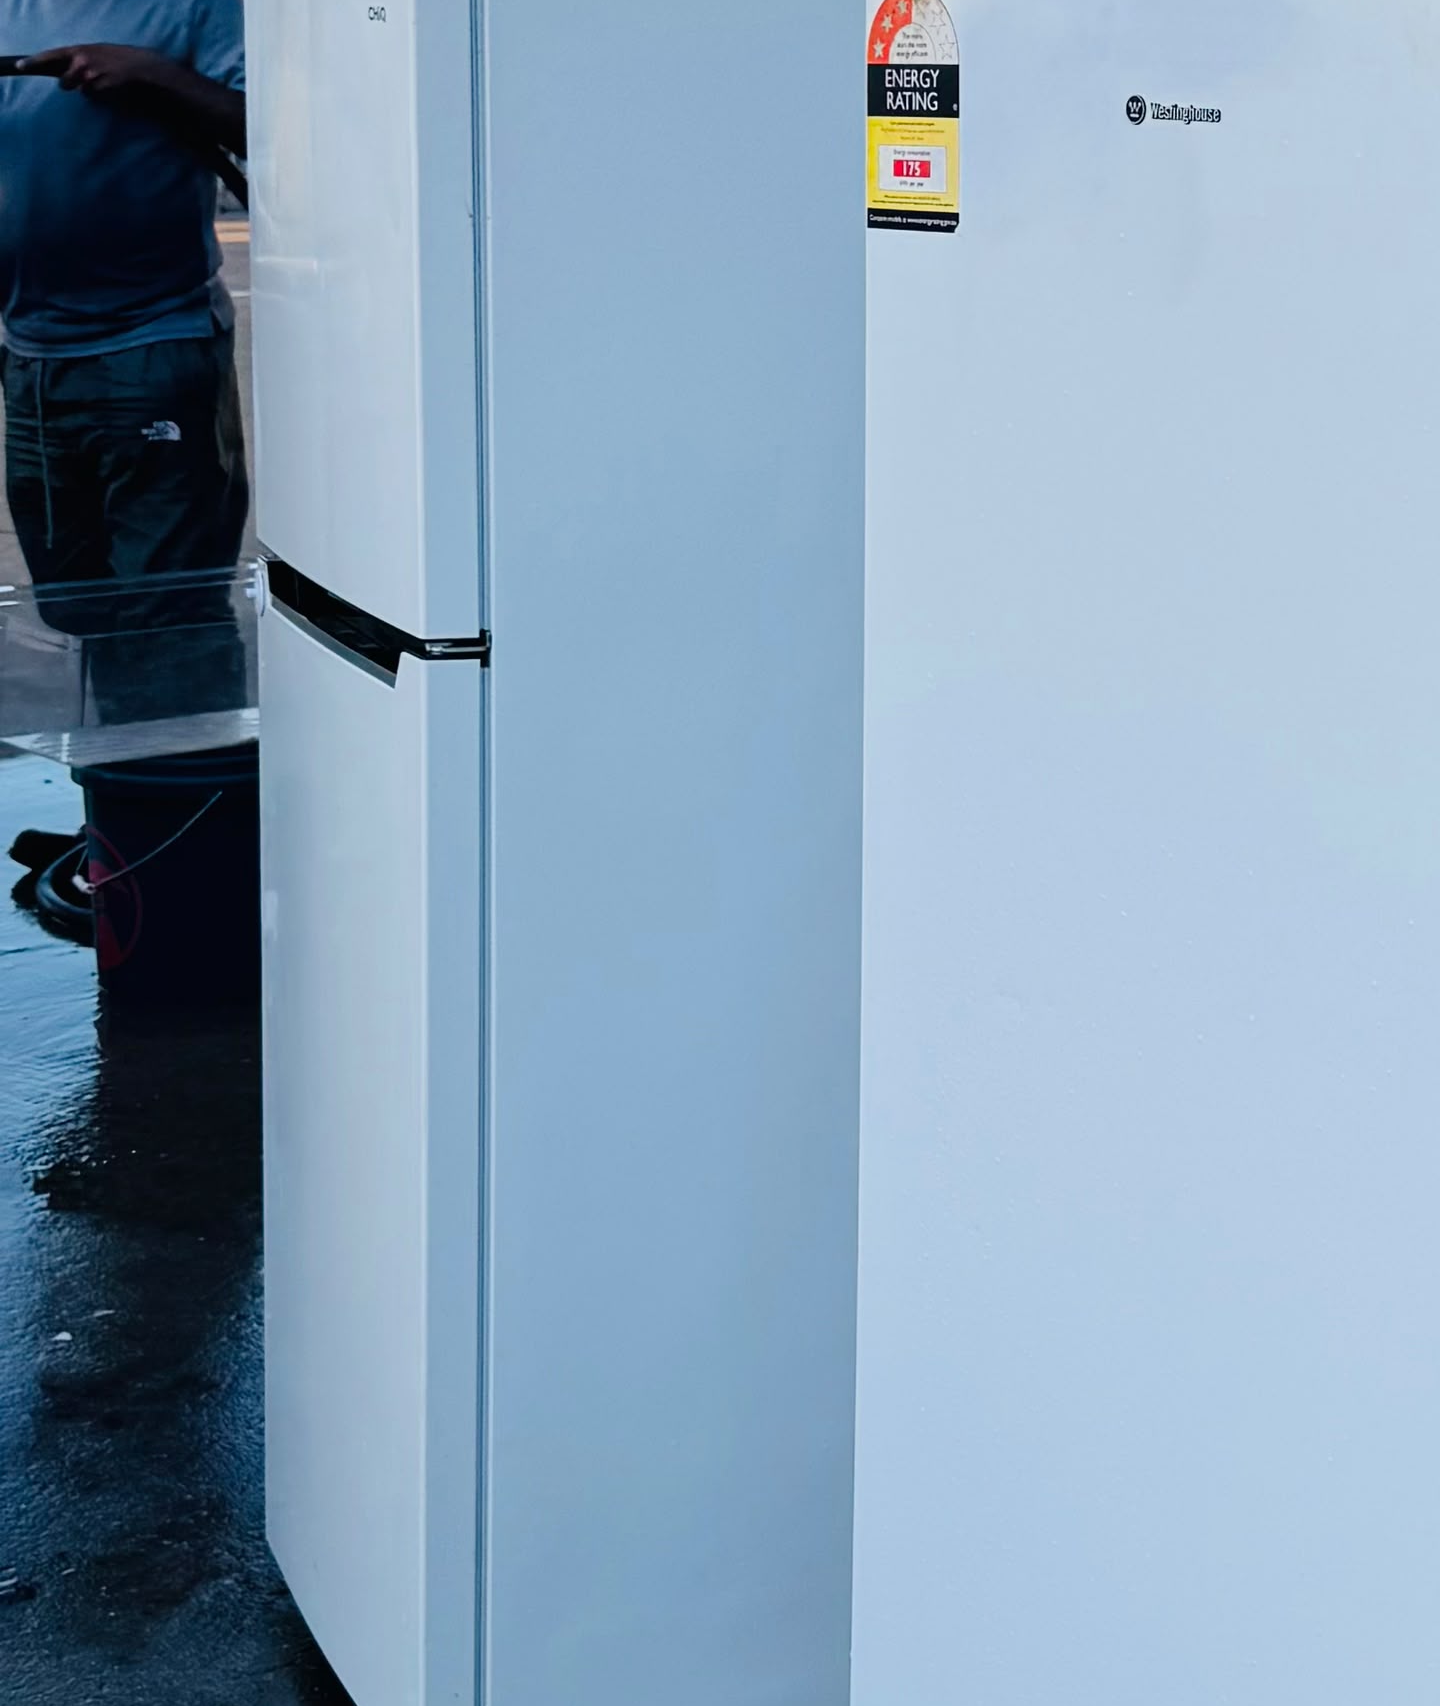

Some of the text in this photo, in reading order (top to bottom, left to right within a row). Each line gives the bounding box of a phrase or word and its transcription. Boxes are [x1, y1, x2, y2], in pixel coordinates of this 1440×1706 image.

[885, 69, 940, 88] ENERGY
[886, 91, 939, 111] RATING
[1150, 102, 1222, 125] Westinghouse
[902, 161, 921, 176] 175
